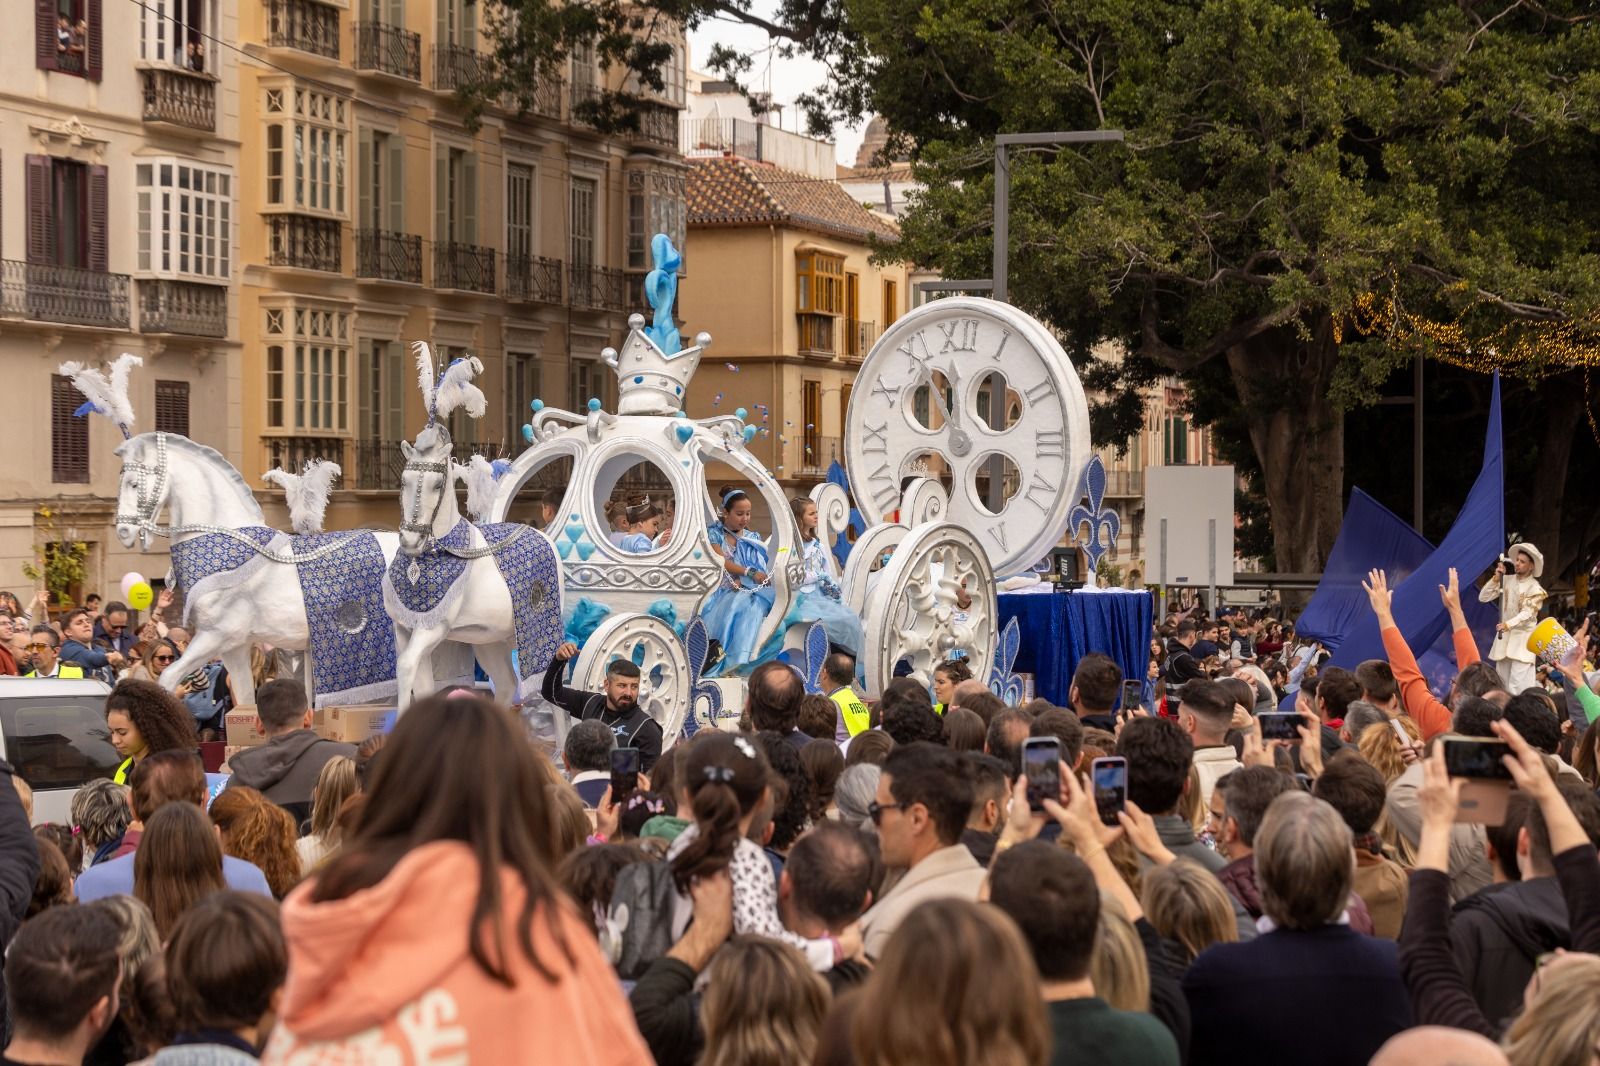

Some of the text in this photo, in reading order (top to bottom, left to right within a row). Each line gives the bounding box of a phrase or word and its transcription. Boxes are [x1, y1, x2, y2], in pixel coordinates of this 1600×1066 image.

[897, 329, 934, 374] XI
[937, 319, 979, 355] XII
[992, 328, 1011, 362] I
[871, 374, 902, 408] X
[1023, 375, 1056, 408] II
[862, 418, 889, 456] IX
[1035, 427, 1065, 459] III
[1024, 469, 1057, 516] IV
[987, 520, 1010, 553] V
